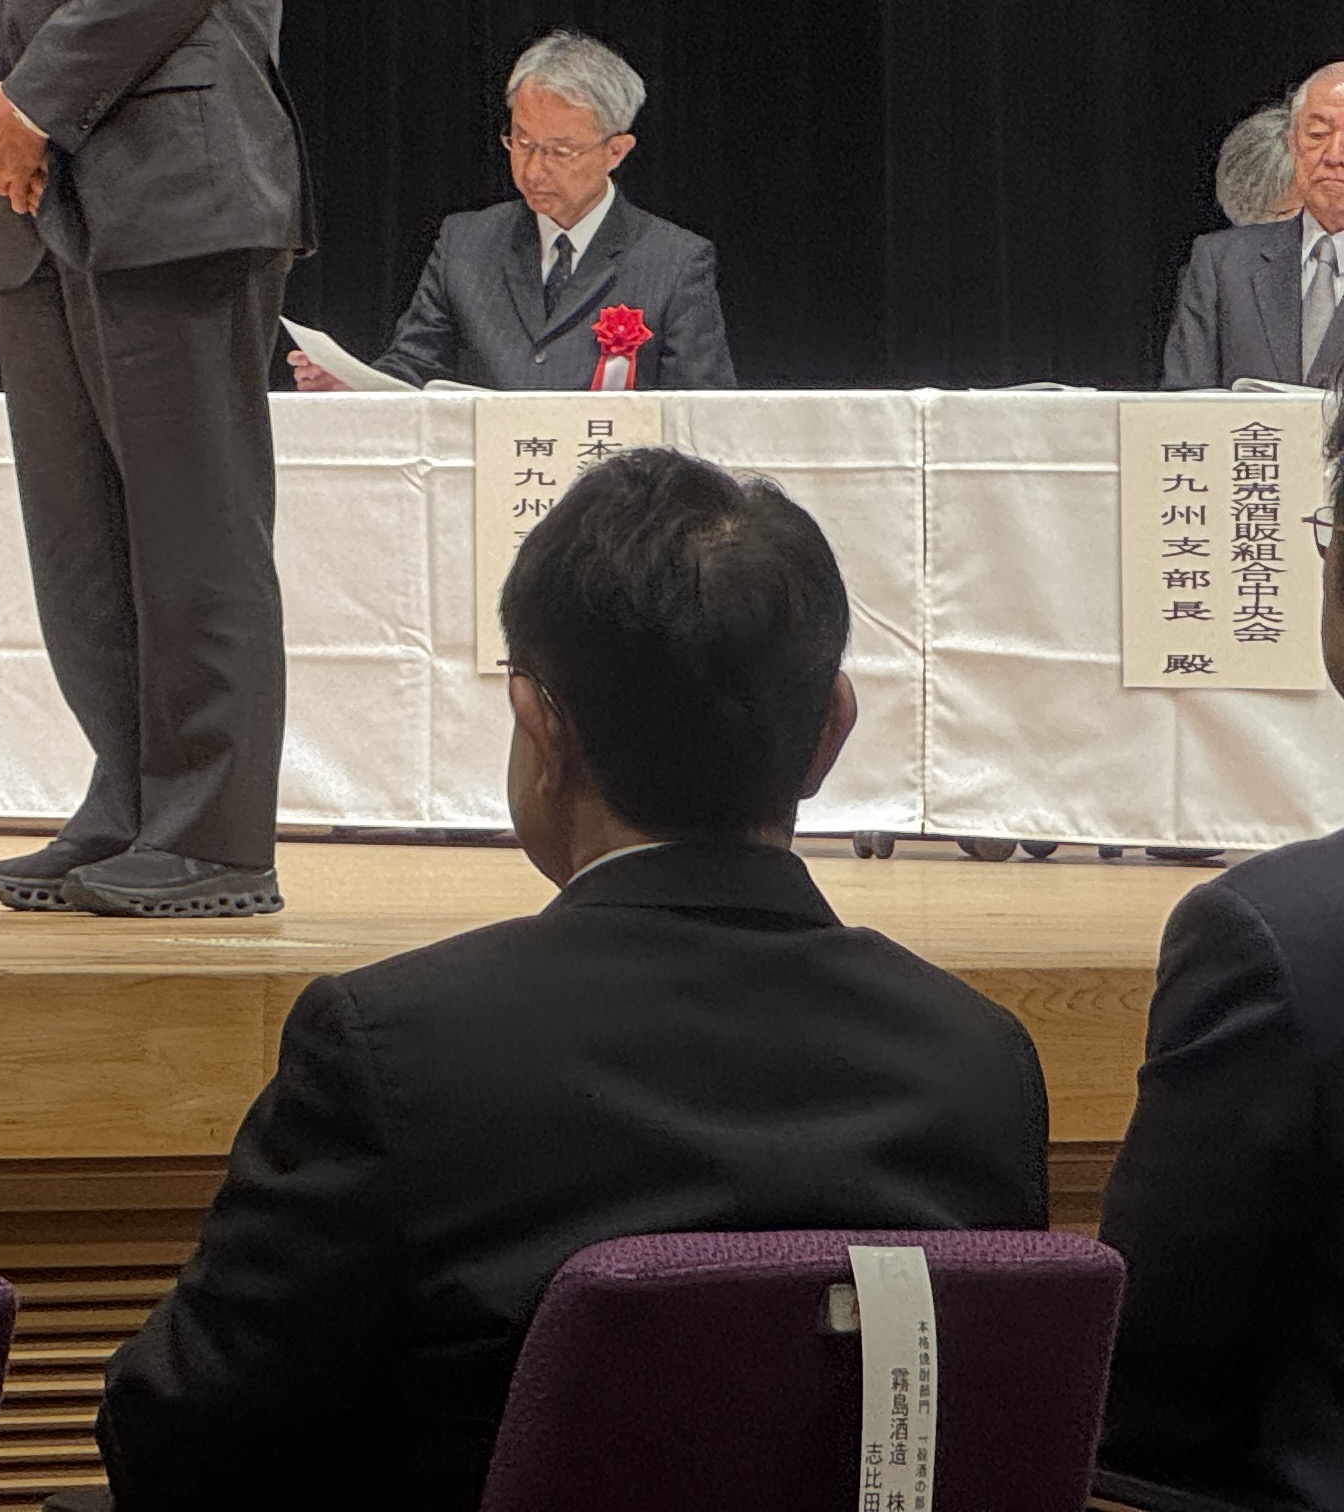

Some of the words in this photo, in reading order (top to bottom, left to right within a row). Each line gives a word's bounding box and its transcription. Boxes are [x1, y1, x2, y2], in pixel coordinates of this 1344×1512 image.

[576, 419, 623, 476] 日本
[1160, 441, 1215, 622] 南九州支部長
[1229, 421, 1288, 644] 全国卸売酒販組合中央会
[1161, 653, 1219, 675] 殿
[888, 1367, 910, 1467] 霧島酒造
[864, 1443, 883, 1512] 志比田
